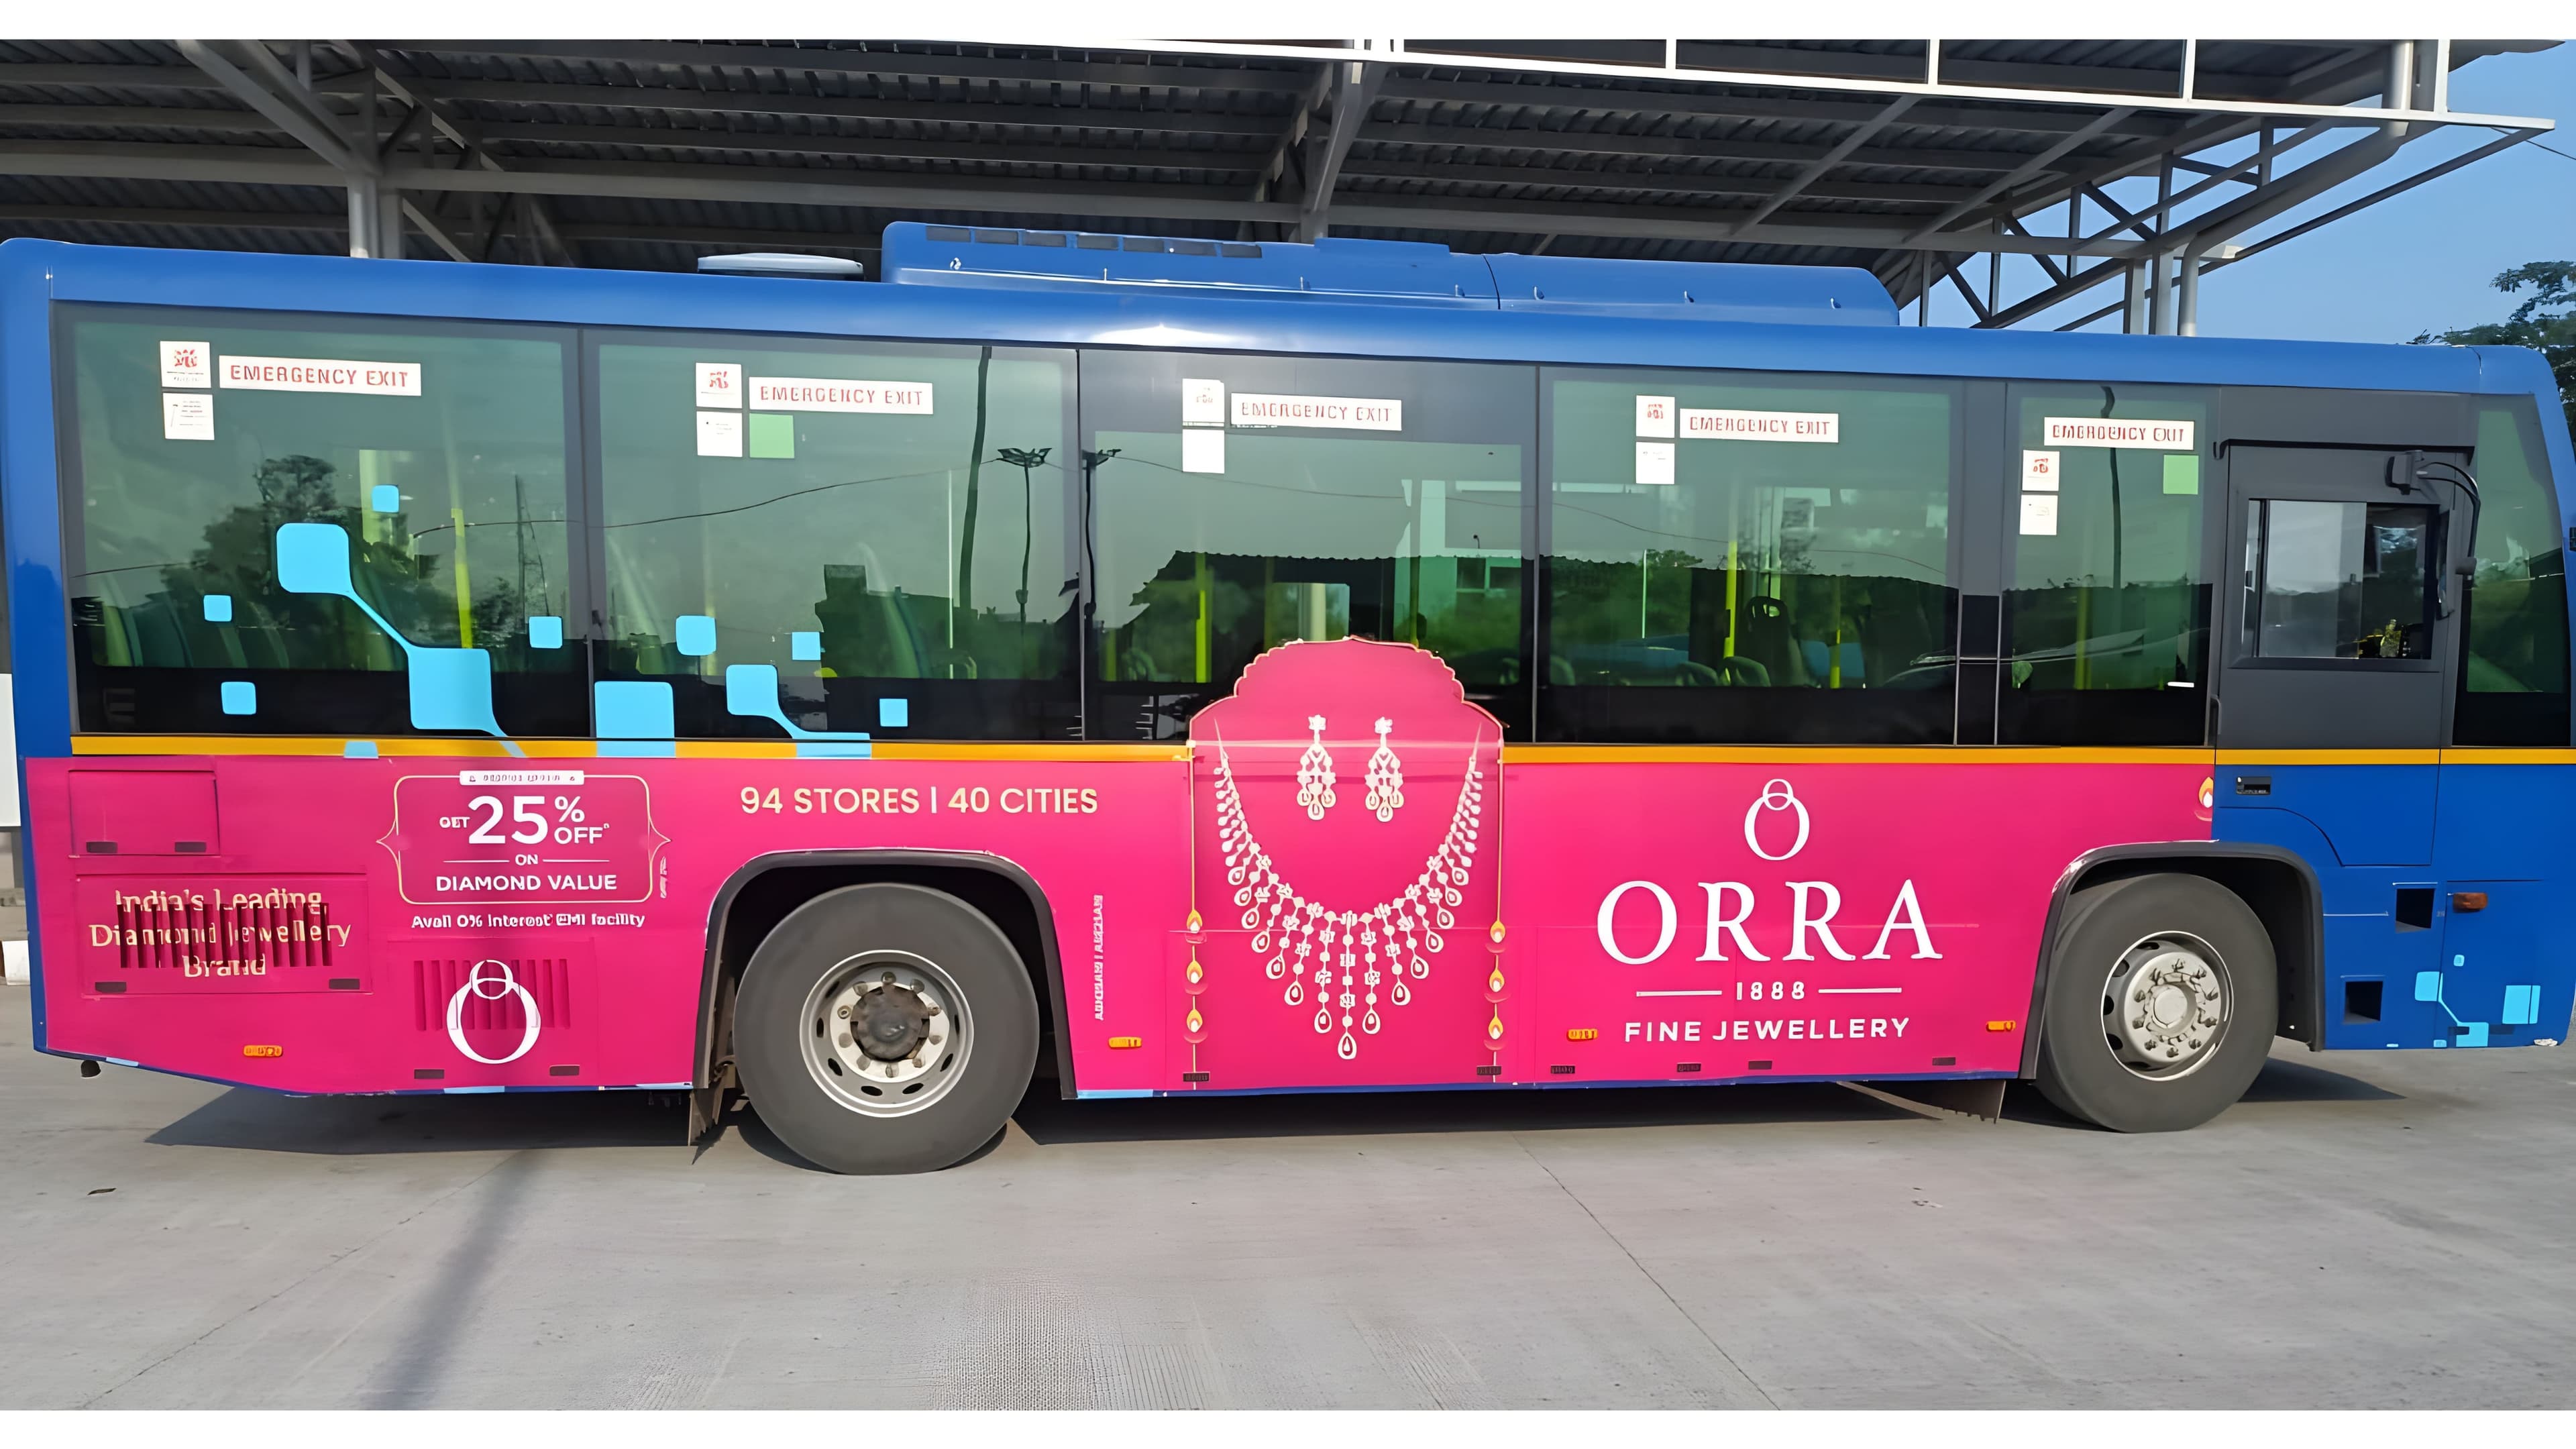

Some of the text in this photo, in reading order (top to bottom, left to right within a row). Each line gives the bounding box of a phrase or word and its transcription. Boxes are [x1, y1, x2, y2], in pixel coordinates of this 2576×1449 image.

[230, 364, 408, 387] EMERGENCY EXIT
[760, 386, 922, 405] EMERGENCY EXIT
[1241, 402, 1393, 422] EMERGENCY EXIT
[741, 786, 784, 814] 94
[794, 788, 920, 814] STORES
[948, 787, 989, 813] 40
[1000, 788, 1097, 814] CITIES
[515, 854, 539, 866] ON
[436, 874, 617, 892] DIAMOND VALUE
[213, 888, 327, 915] Leading
[457, 914, 483, 928] 0%
[1597, 879, 1943, 965] ORRA
[89, 922, 217, 947] Diamond
[182, 953, 266, 977] Brand
[1737, 981, 1805, 1000] 1888
[1625, 1017, 1909, 1042] FINE JEWELLERY
